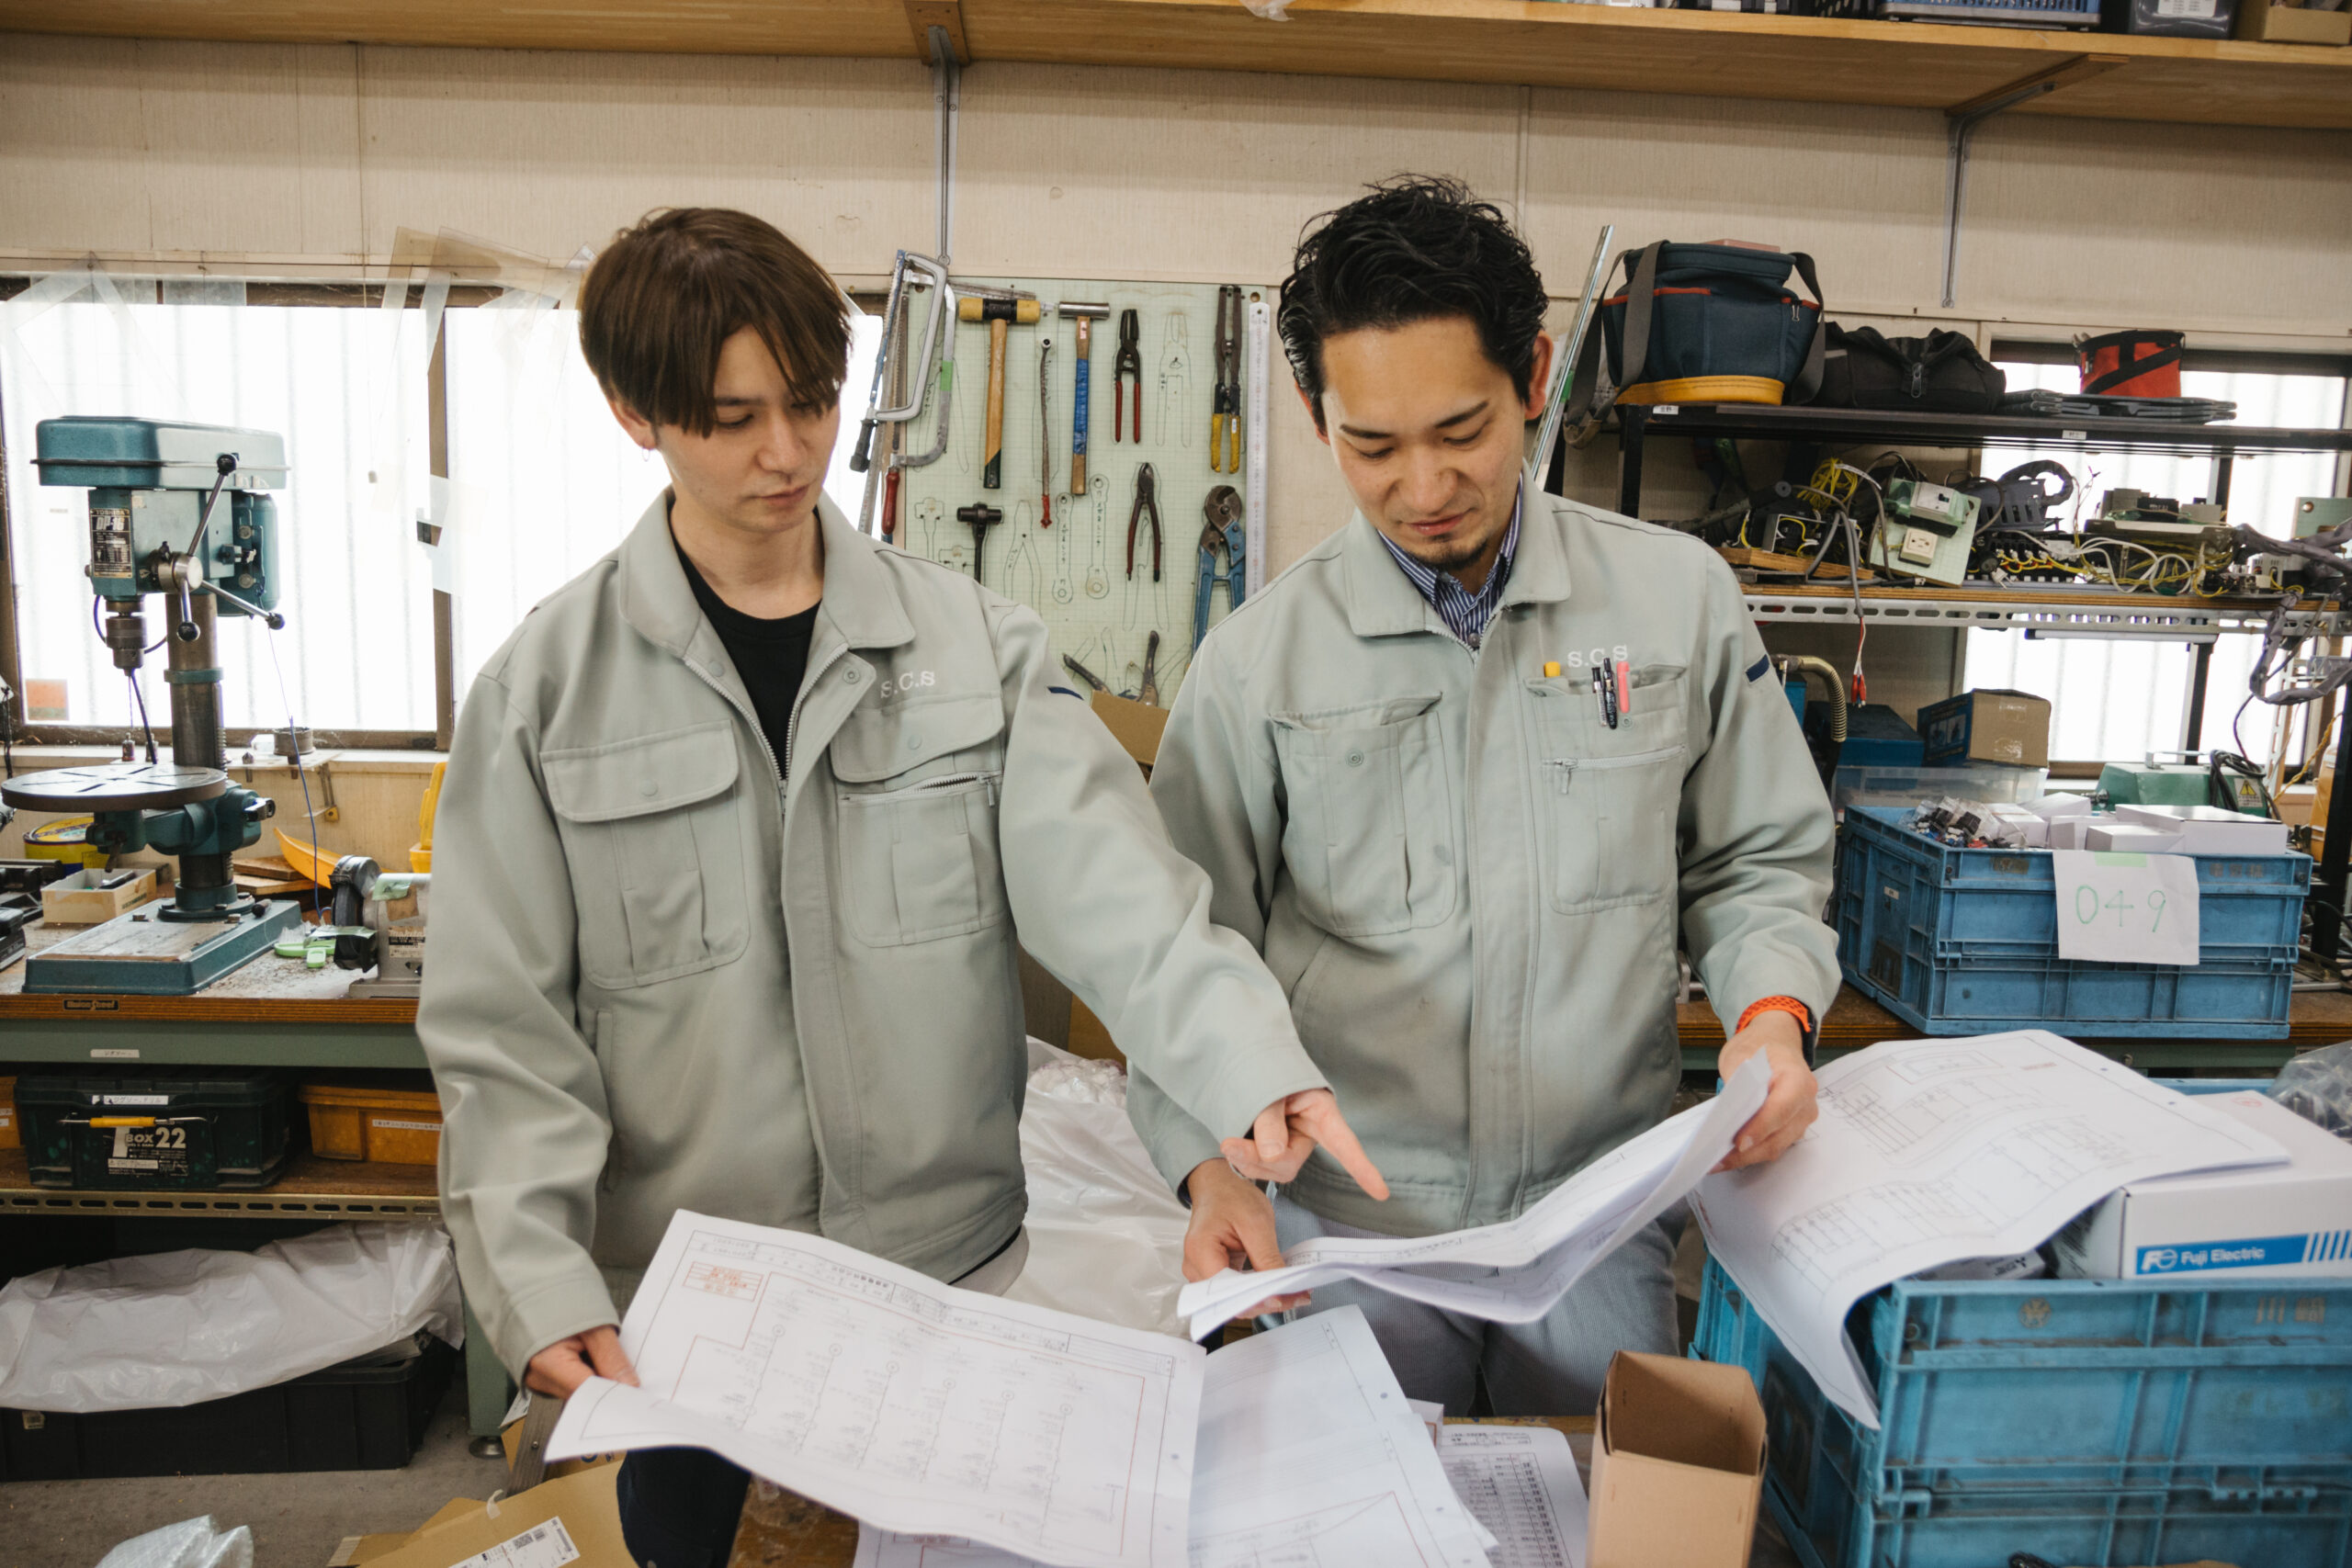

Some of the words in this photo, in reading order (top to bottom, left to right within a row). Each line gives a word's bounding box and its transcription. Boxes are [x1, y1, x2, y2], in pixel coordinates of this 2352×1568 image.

[879, 670, 936, 699] S.C.S
[2075, 884, 2168, 934] 049
[154, 1126, 187, 1149] 22
[2181, 1250, 2208, 1267] Fuji
[2211, 1246, 2266, 1263] Electric
